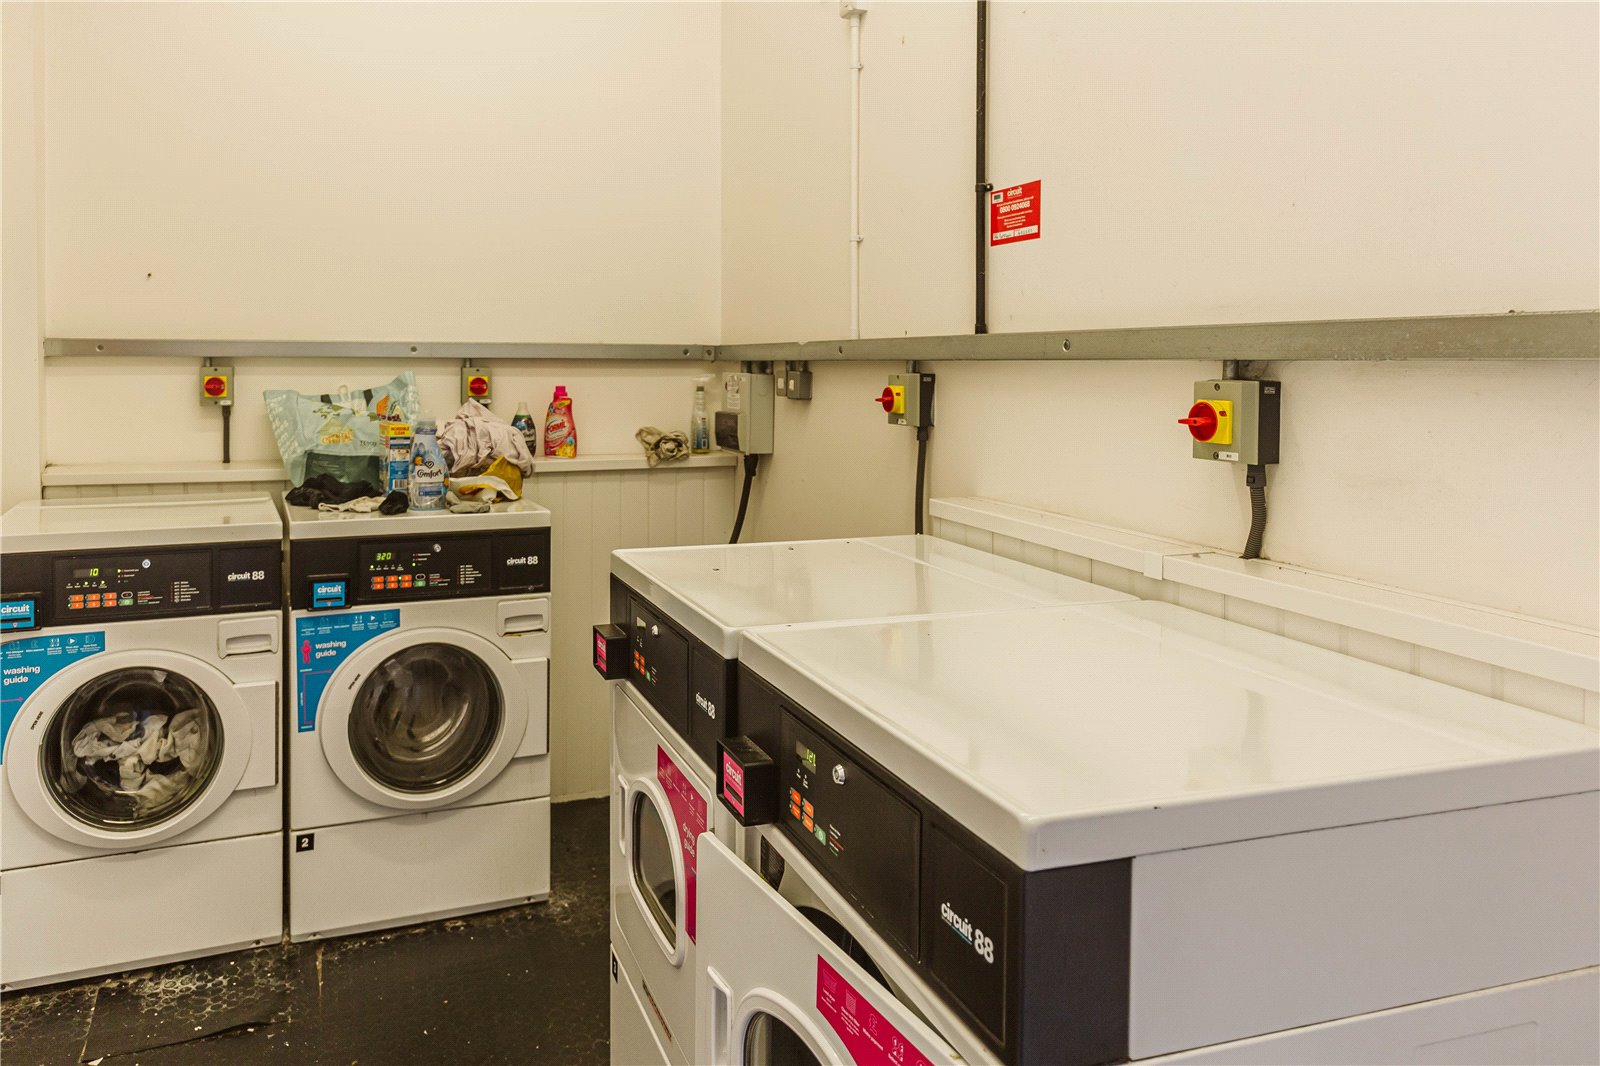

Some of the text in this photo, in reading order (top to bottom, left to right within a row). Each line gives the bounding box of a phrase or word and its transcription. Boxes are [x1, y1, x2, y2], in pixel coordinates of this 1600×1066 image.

[416, 469, 442, 479] Comfort
[376, 552, 392, 561] 320
[507, 555, 539, 565] circuit 88
[89, 568, 99, 576] 10
[227, 570, 265, 582] circuit 88
[317, 584, 342, 594] circuit
[1, 603, 30, 614] circuit
[315, 640, 347, 650] washing
[315, 649, 337, 659] guide
[3, 665, 41, 676] washing
[3, 675, 29, 686] guide
[707, 701, 716, 720] 88
[725, 762, 742, 786] circuit
[302, 837, 309, 848] 2
[941, 902, 995, 964] circuit 88
